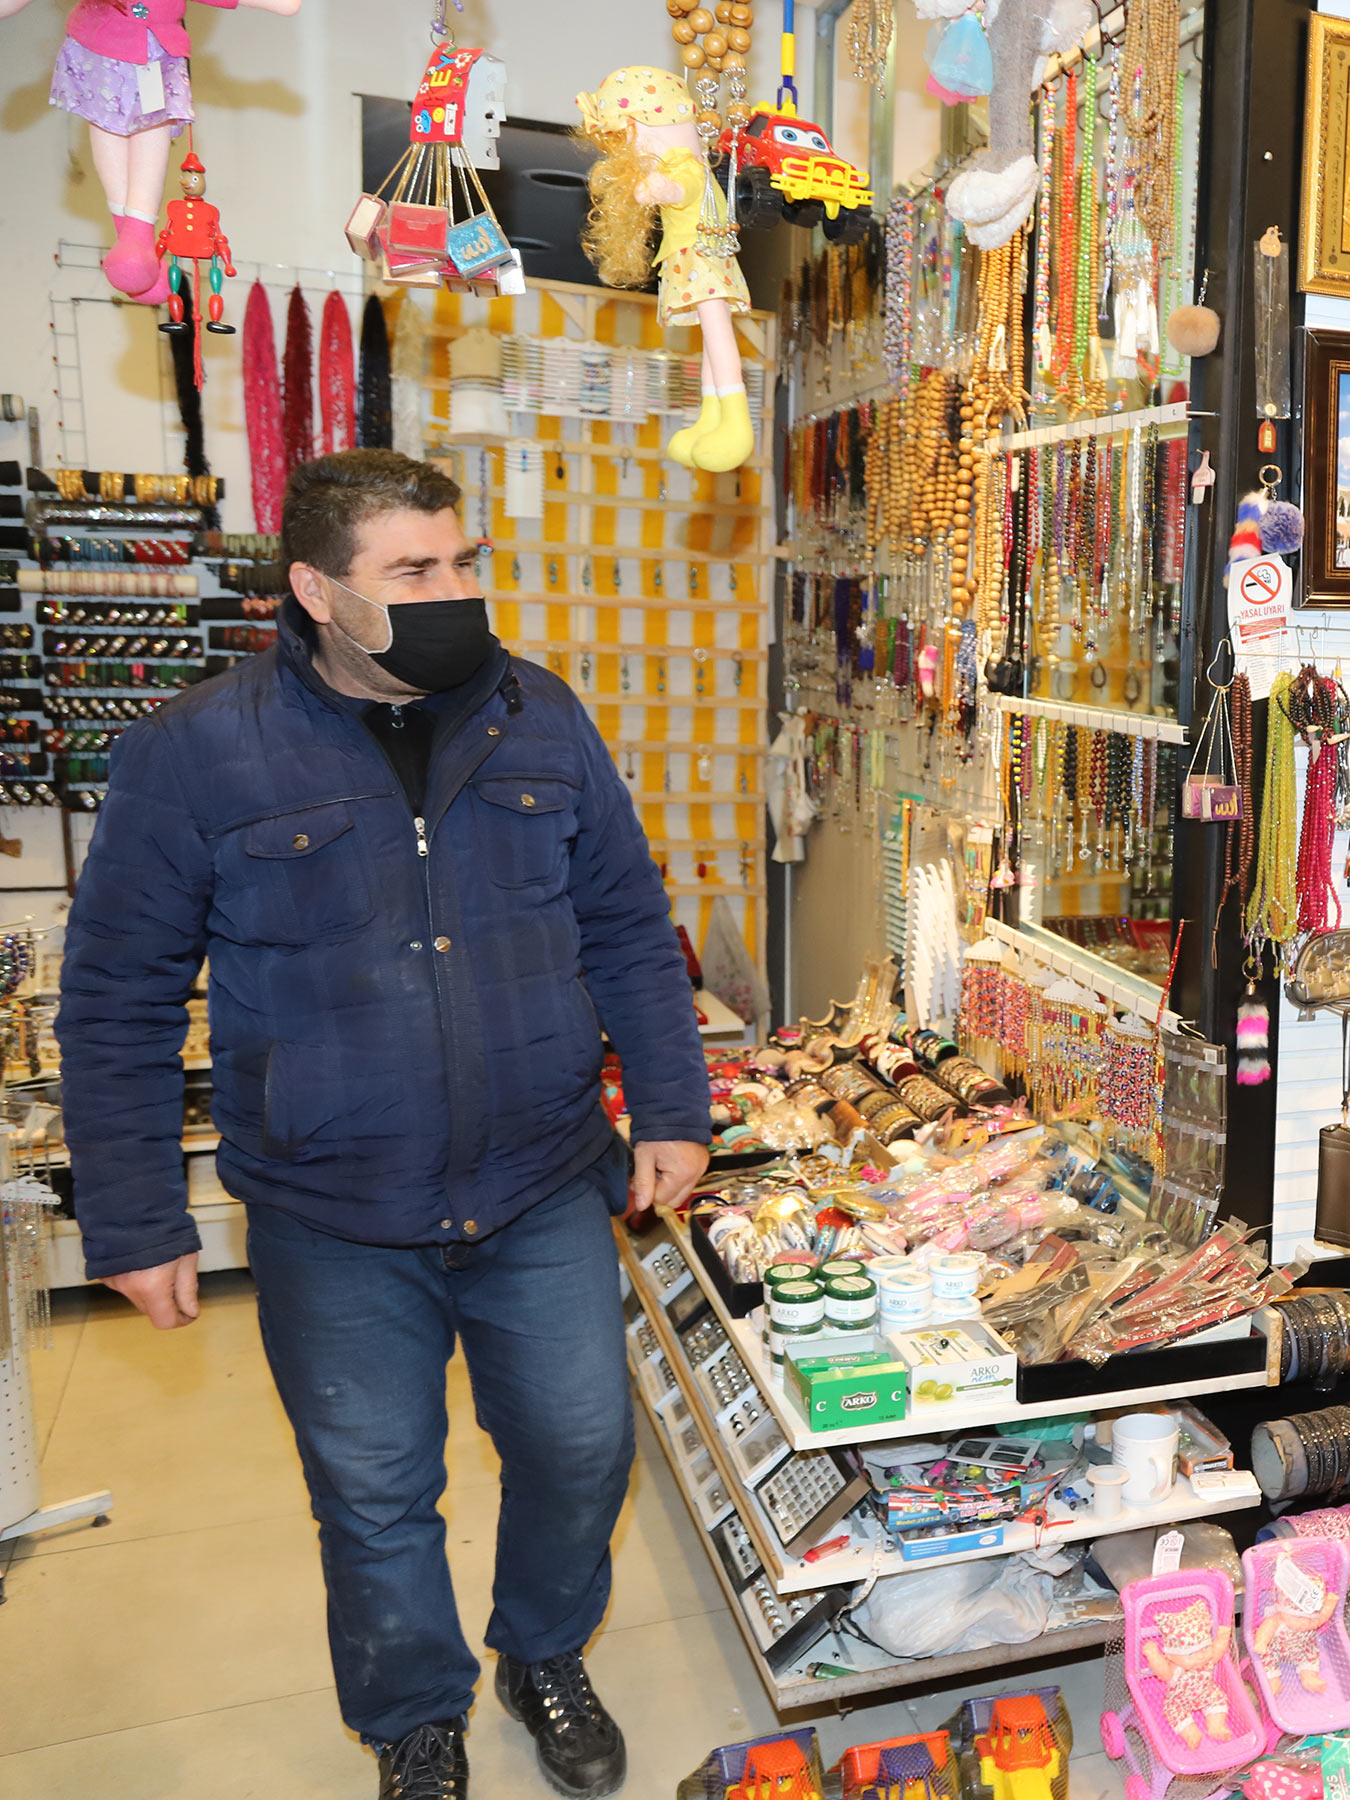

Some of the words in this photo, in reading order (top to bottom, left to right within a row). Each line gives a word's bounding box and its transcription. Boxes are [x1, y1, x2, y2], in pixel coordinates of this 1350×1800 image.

[1240, 607, 1263, 619] YASAL
[1264, 603, 1285, 616] UYARI
[944, 1280, 964, 1289] ARKO
[888, 1298, 907, 1307] ARKO
[777, 1308, 799, 1318] ARKO
[970, 1364, 1000, 1378] ARKO
[844, 1394, 875, 1407] ARKO
[891, 1390, 902, 1402] C
[815, 1401, 827, 1413] C
